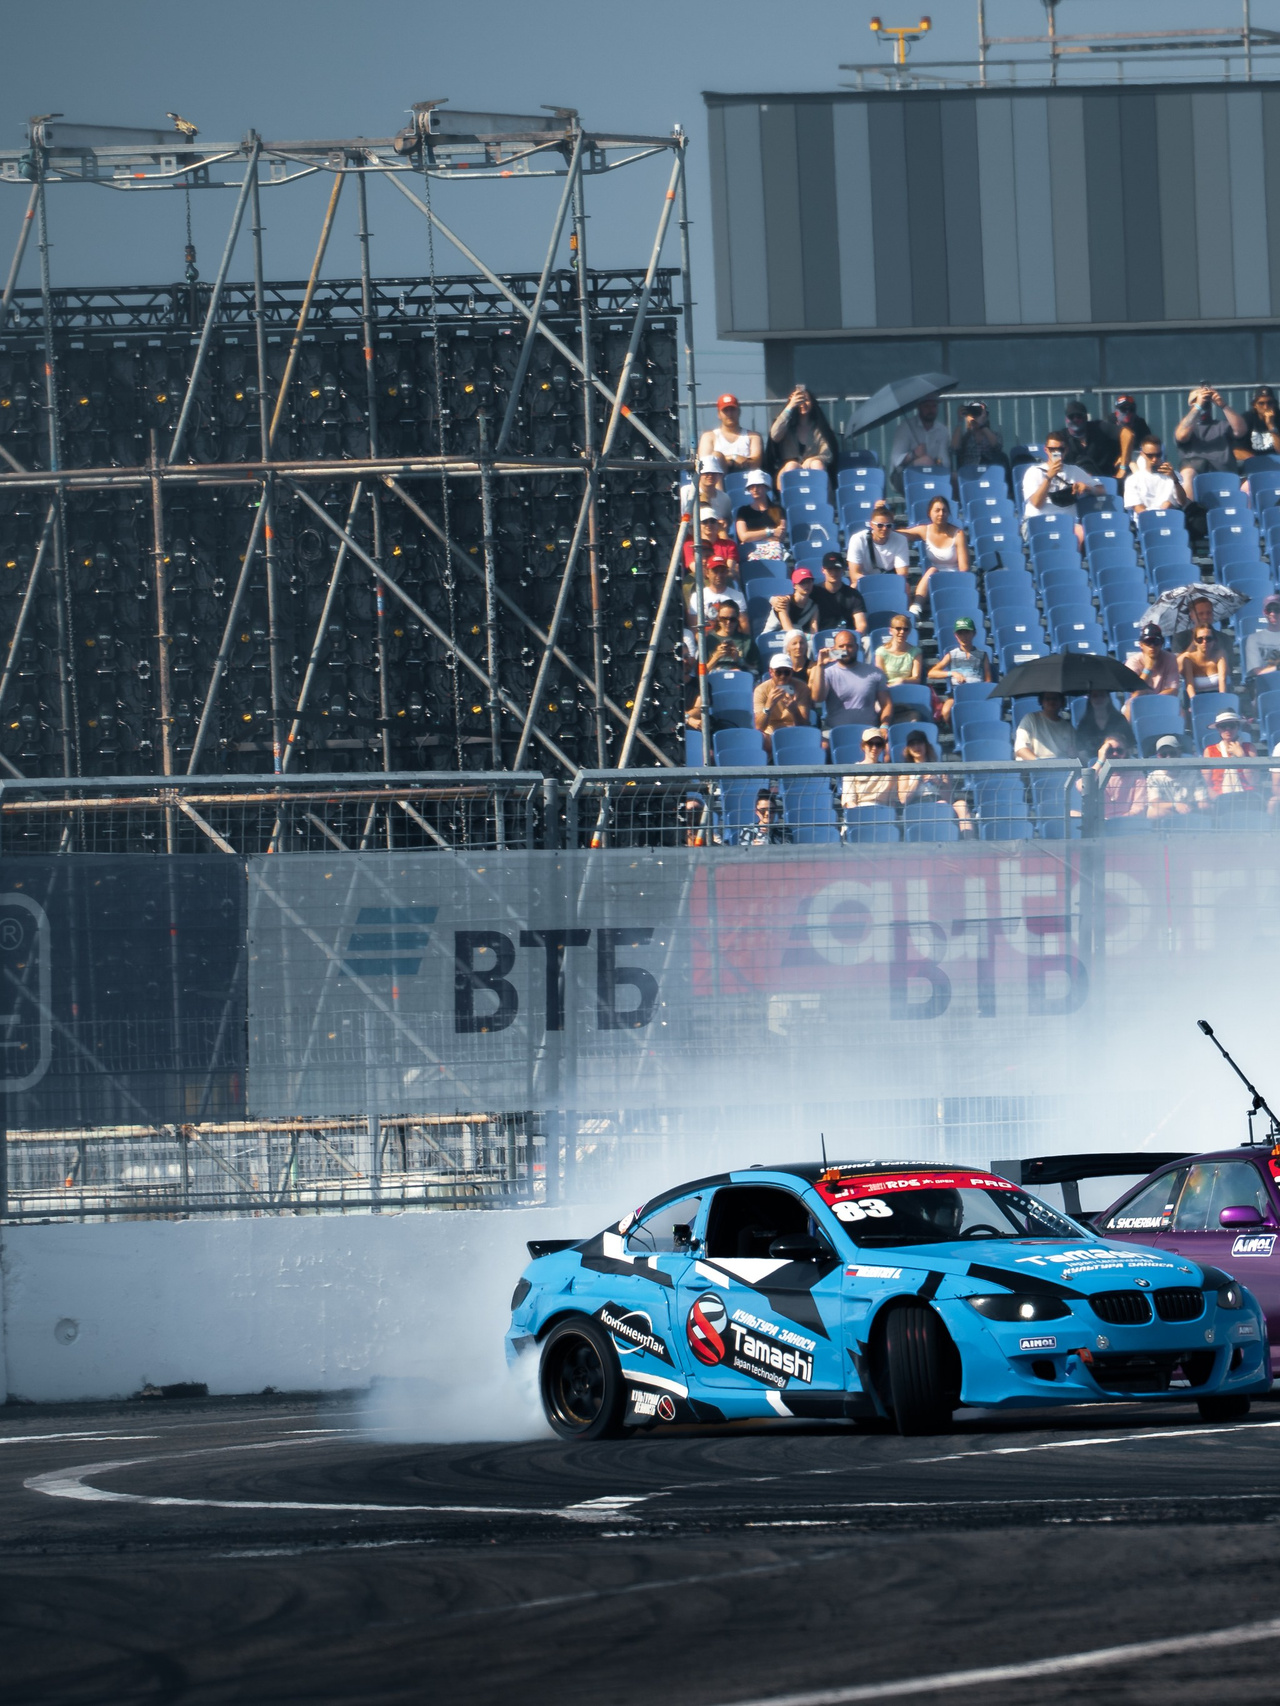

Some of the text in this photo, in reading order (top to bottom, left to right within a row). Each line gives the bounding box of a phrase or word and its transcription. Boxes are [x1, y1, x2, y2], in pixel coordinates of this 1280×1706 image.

[889, 914, 1090, 1021] ВТБ
[455, 927, 660, 1033] ВТБ
[969, 1177, 1012, 1189] PRO
[831, 1198, 893, 1222] 83
[1117, 1216, 1163, 1229] SHCHERBAK
[1234, 1238, 1273, 1252] AIMOL
[1063, 1262, 1124, 1275] КУЛЬТУРА
[600, 1309, 665, 1355] КонтинентПак
[732, 1308, 817, 1352] КУЛЬТУРА ЗАНОСА
[730, 1322, 813, 1382] Tamashi
[1022, 1338, 1055, 1349] AIMOL
[751, 1363, 787, 1388] technology
